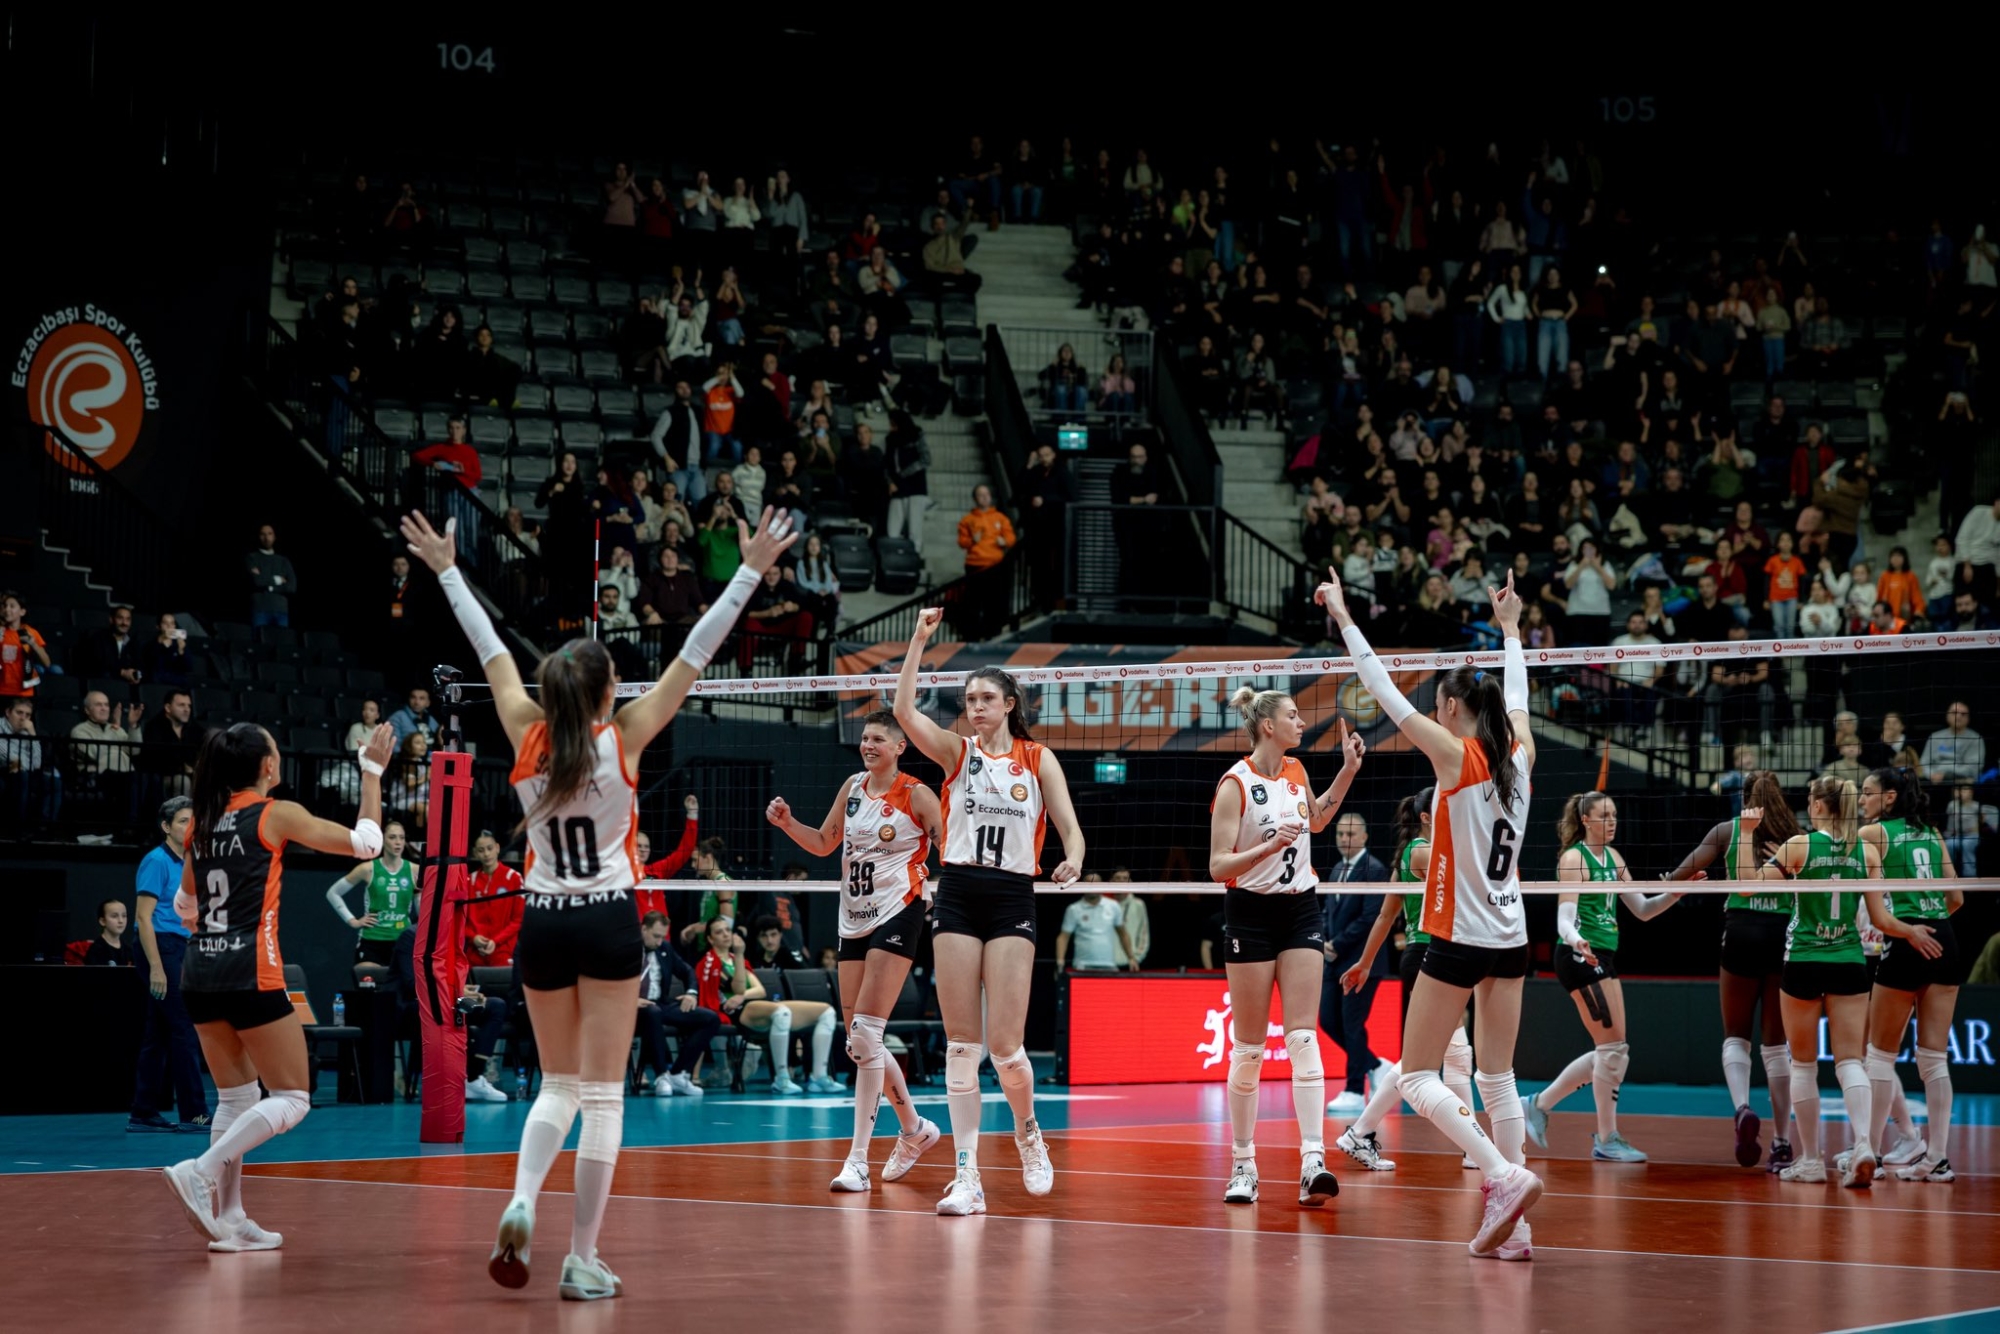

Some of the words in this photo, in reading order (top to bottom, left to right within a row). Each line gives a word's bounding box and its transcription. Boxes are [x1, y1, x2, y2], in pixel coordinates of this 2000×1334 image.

[436, 42, 497, 74] 104
[1599, 95, 1656, 123] 105
[11, 306, 79, 388] Eczacıbaşı
[85, 303, 126, 335] Spor
[126, 333, 159, 411] Kulübü
[978, 804, 1027, 819] Eczacıbaşı
[546, 816, 600, 880] 10
[975, 824, 1005, 867] 14
[1486, 817, 1516, 881] 6
[1278, 847, 1298, 885] 3
[1434, 853, 1447, 914] PEGASUS
[205, 869, 230, 933] 2
[389, 892, 397, 908] 9
[848, 907, 880, 921] Dynavit
[1749, 897, 1778, 910] IMAN
[1232, 938, 1240, 953] 3
